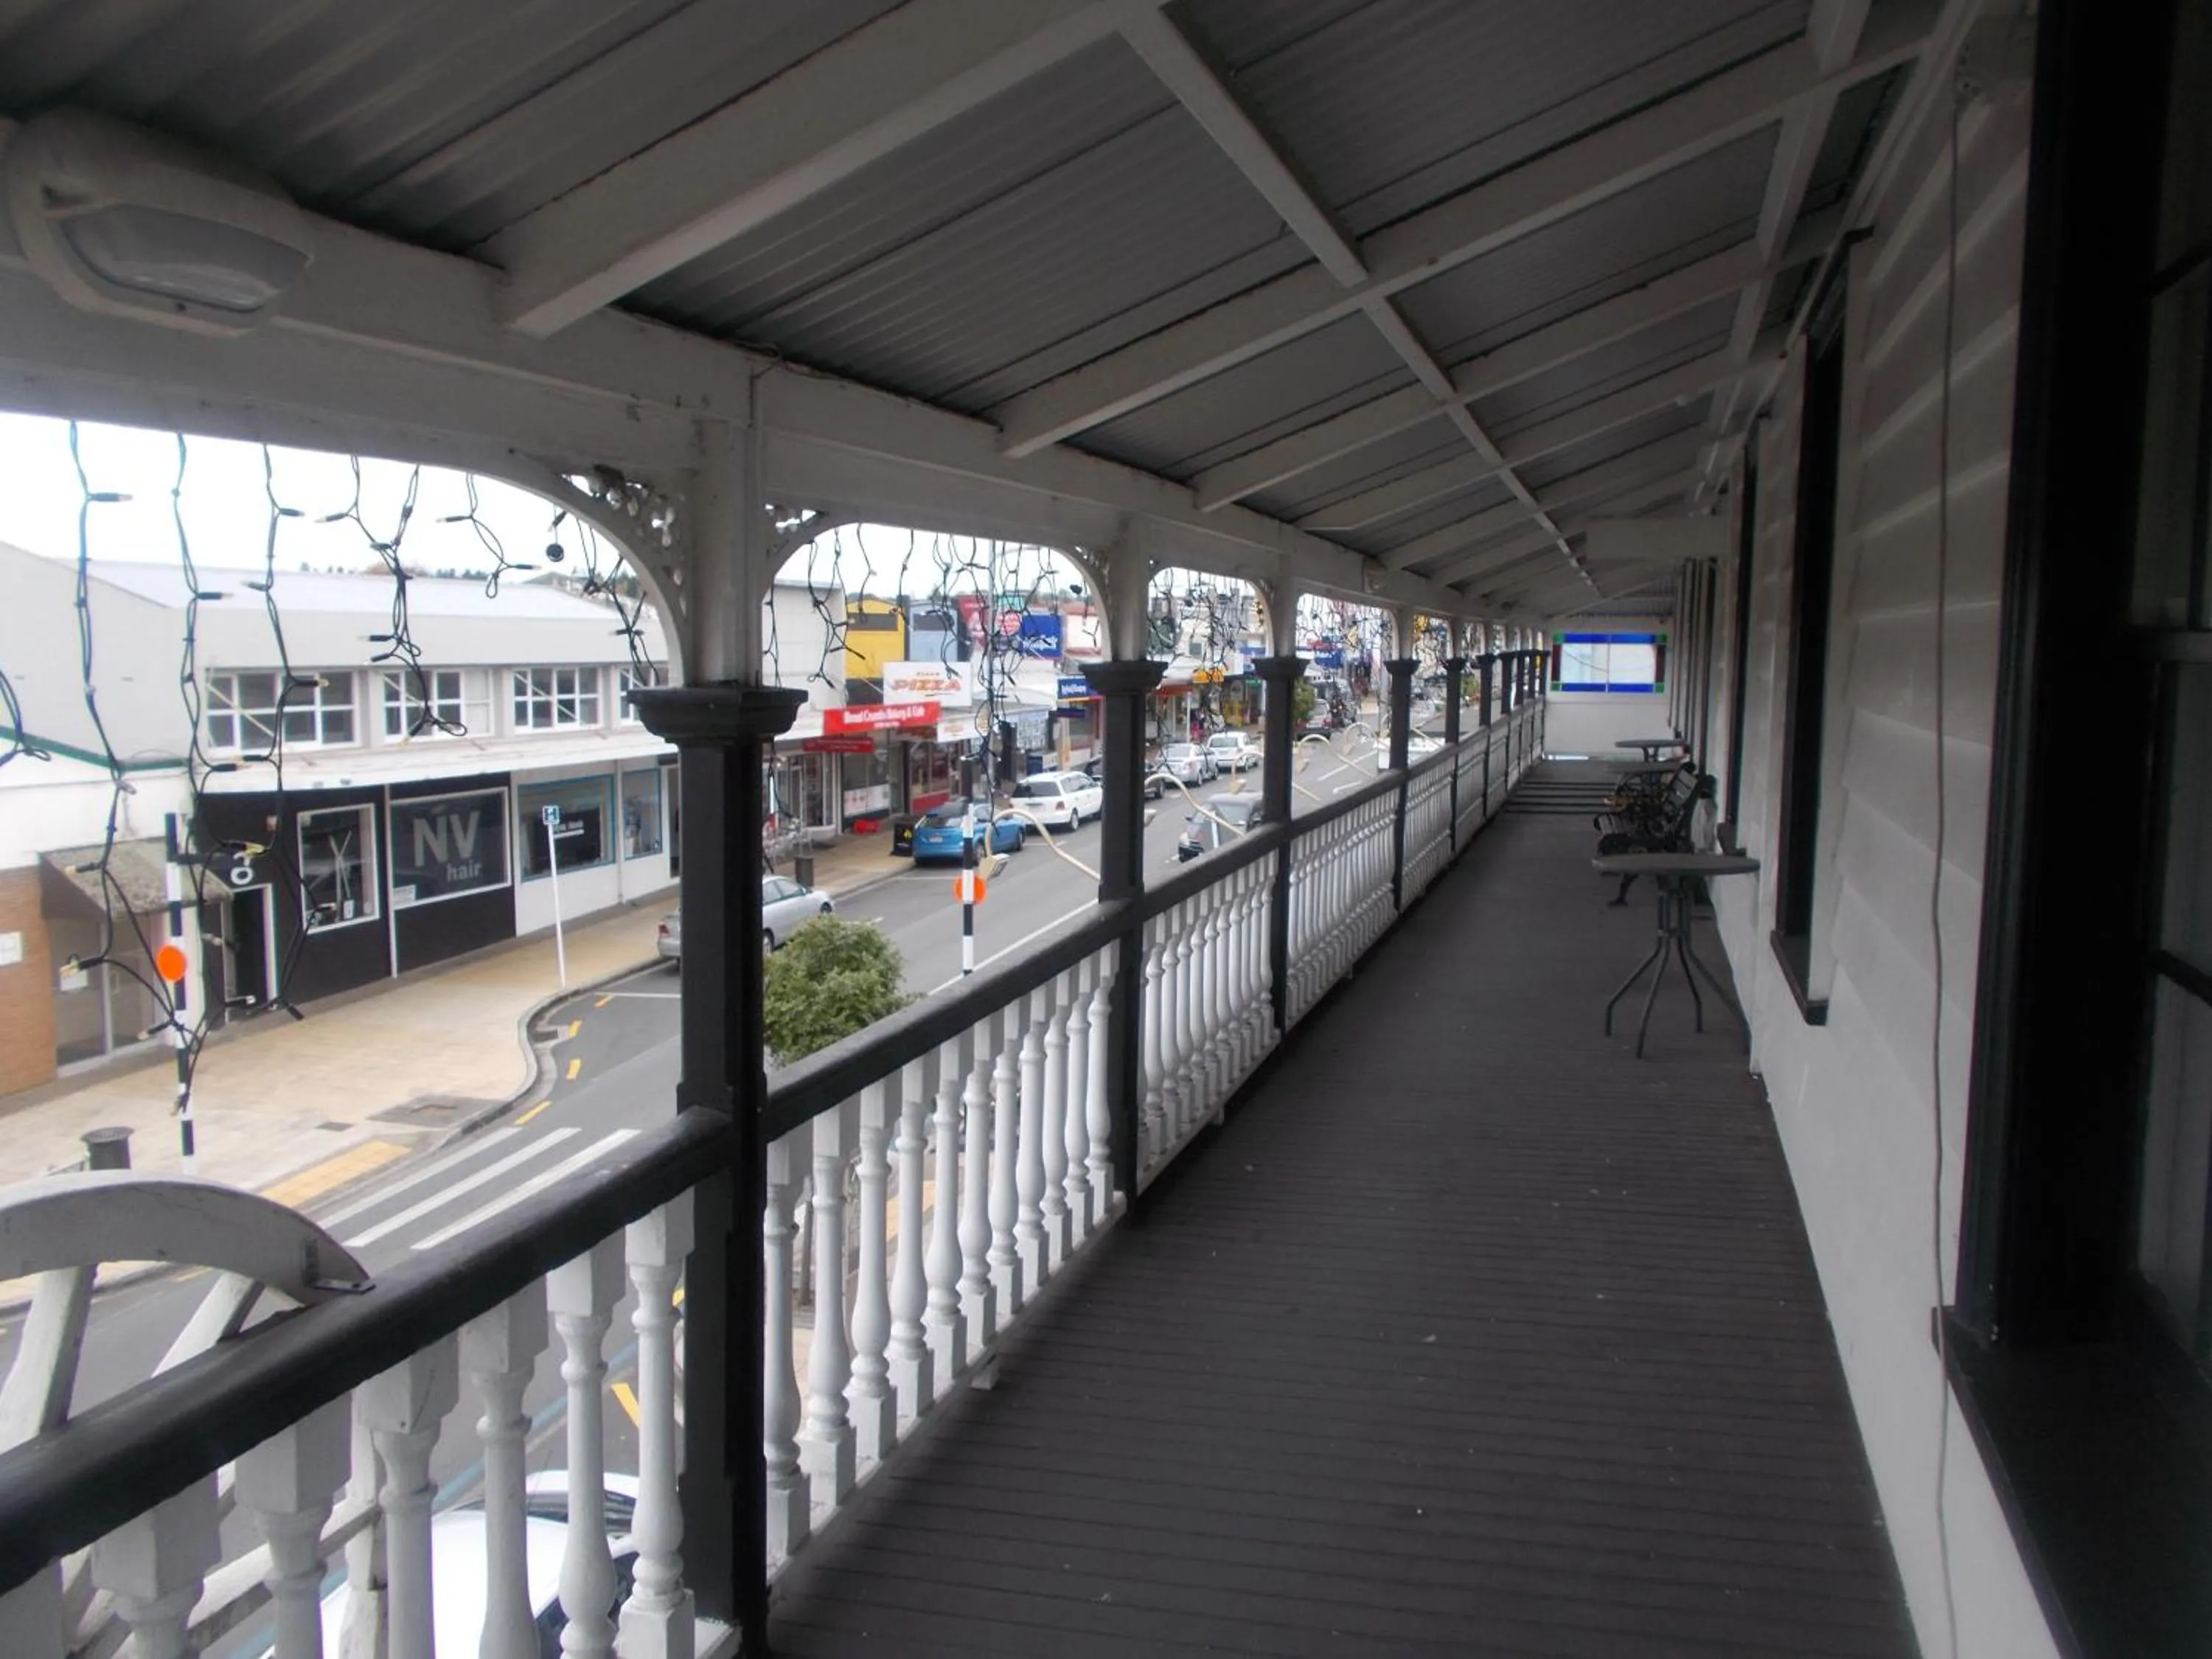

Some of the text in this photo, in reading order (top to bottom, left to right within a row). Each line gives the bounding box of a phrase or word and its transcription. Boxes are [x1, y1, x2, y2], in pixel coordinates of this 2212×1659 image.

[890, 679, 961, 691] PIZZA
[413, 810, 481, 867] NV
[446, 860, 483, 881] hair
